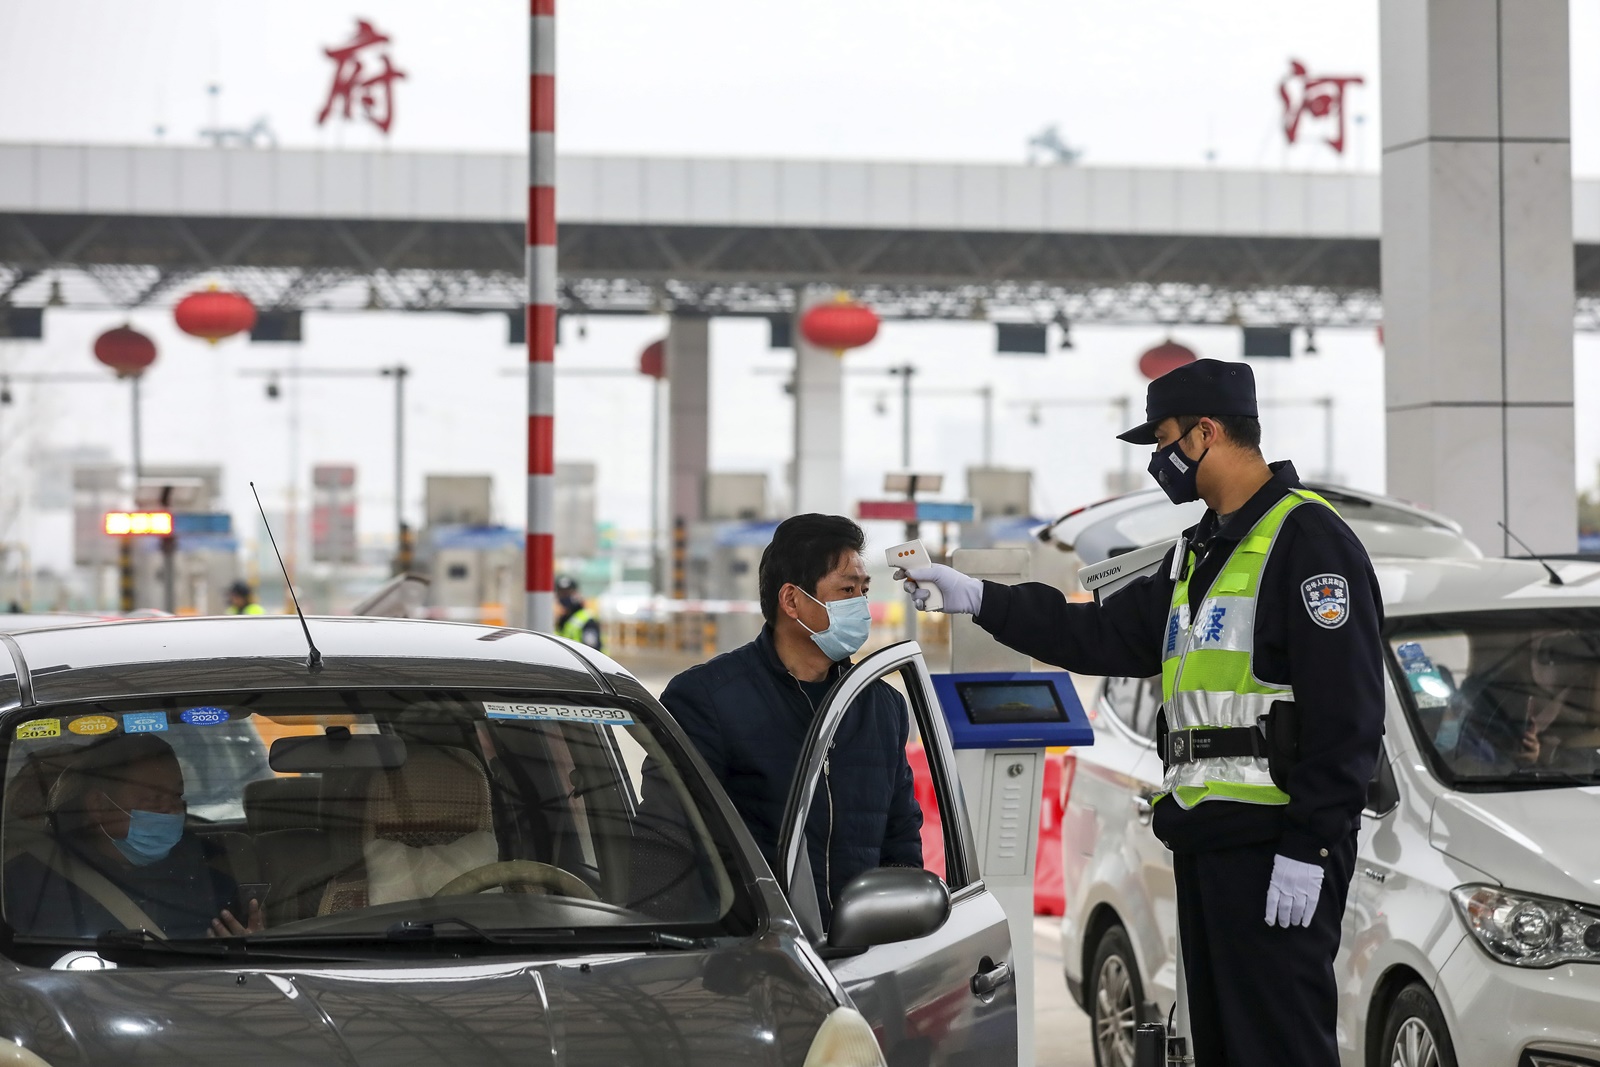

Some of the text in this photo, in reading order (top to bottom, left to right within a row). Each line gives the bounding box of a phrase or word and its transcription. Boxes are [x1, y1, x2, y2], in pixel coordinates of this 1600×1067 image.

[317, 18, 1364, 153] 府 河
[1086, 565, 1122, 584] HIKVISION
[1200, 605, 1227, 642] 察
[191, 714, 219, 722] 2020
[509, 705, 625, 720] 15927210990
[80, 723, 107, 731] 2019
[129, 723, 164, 732] 2019
[22, 730, 57, 738] 2020
